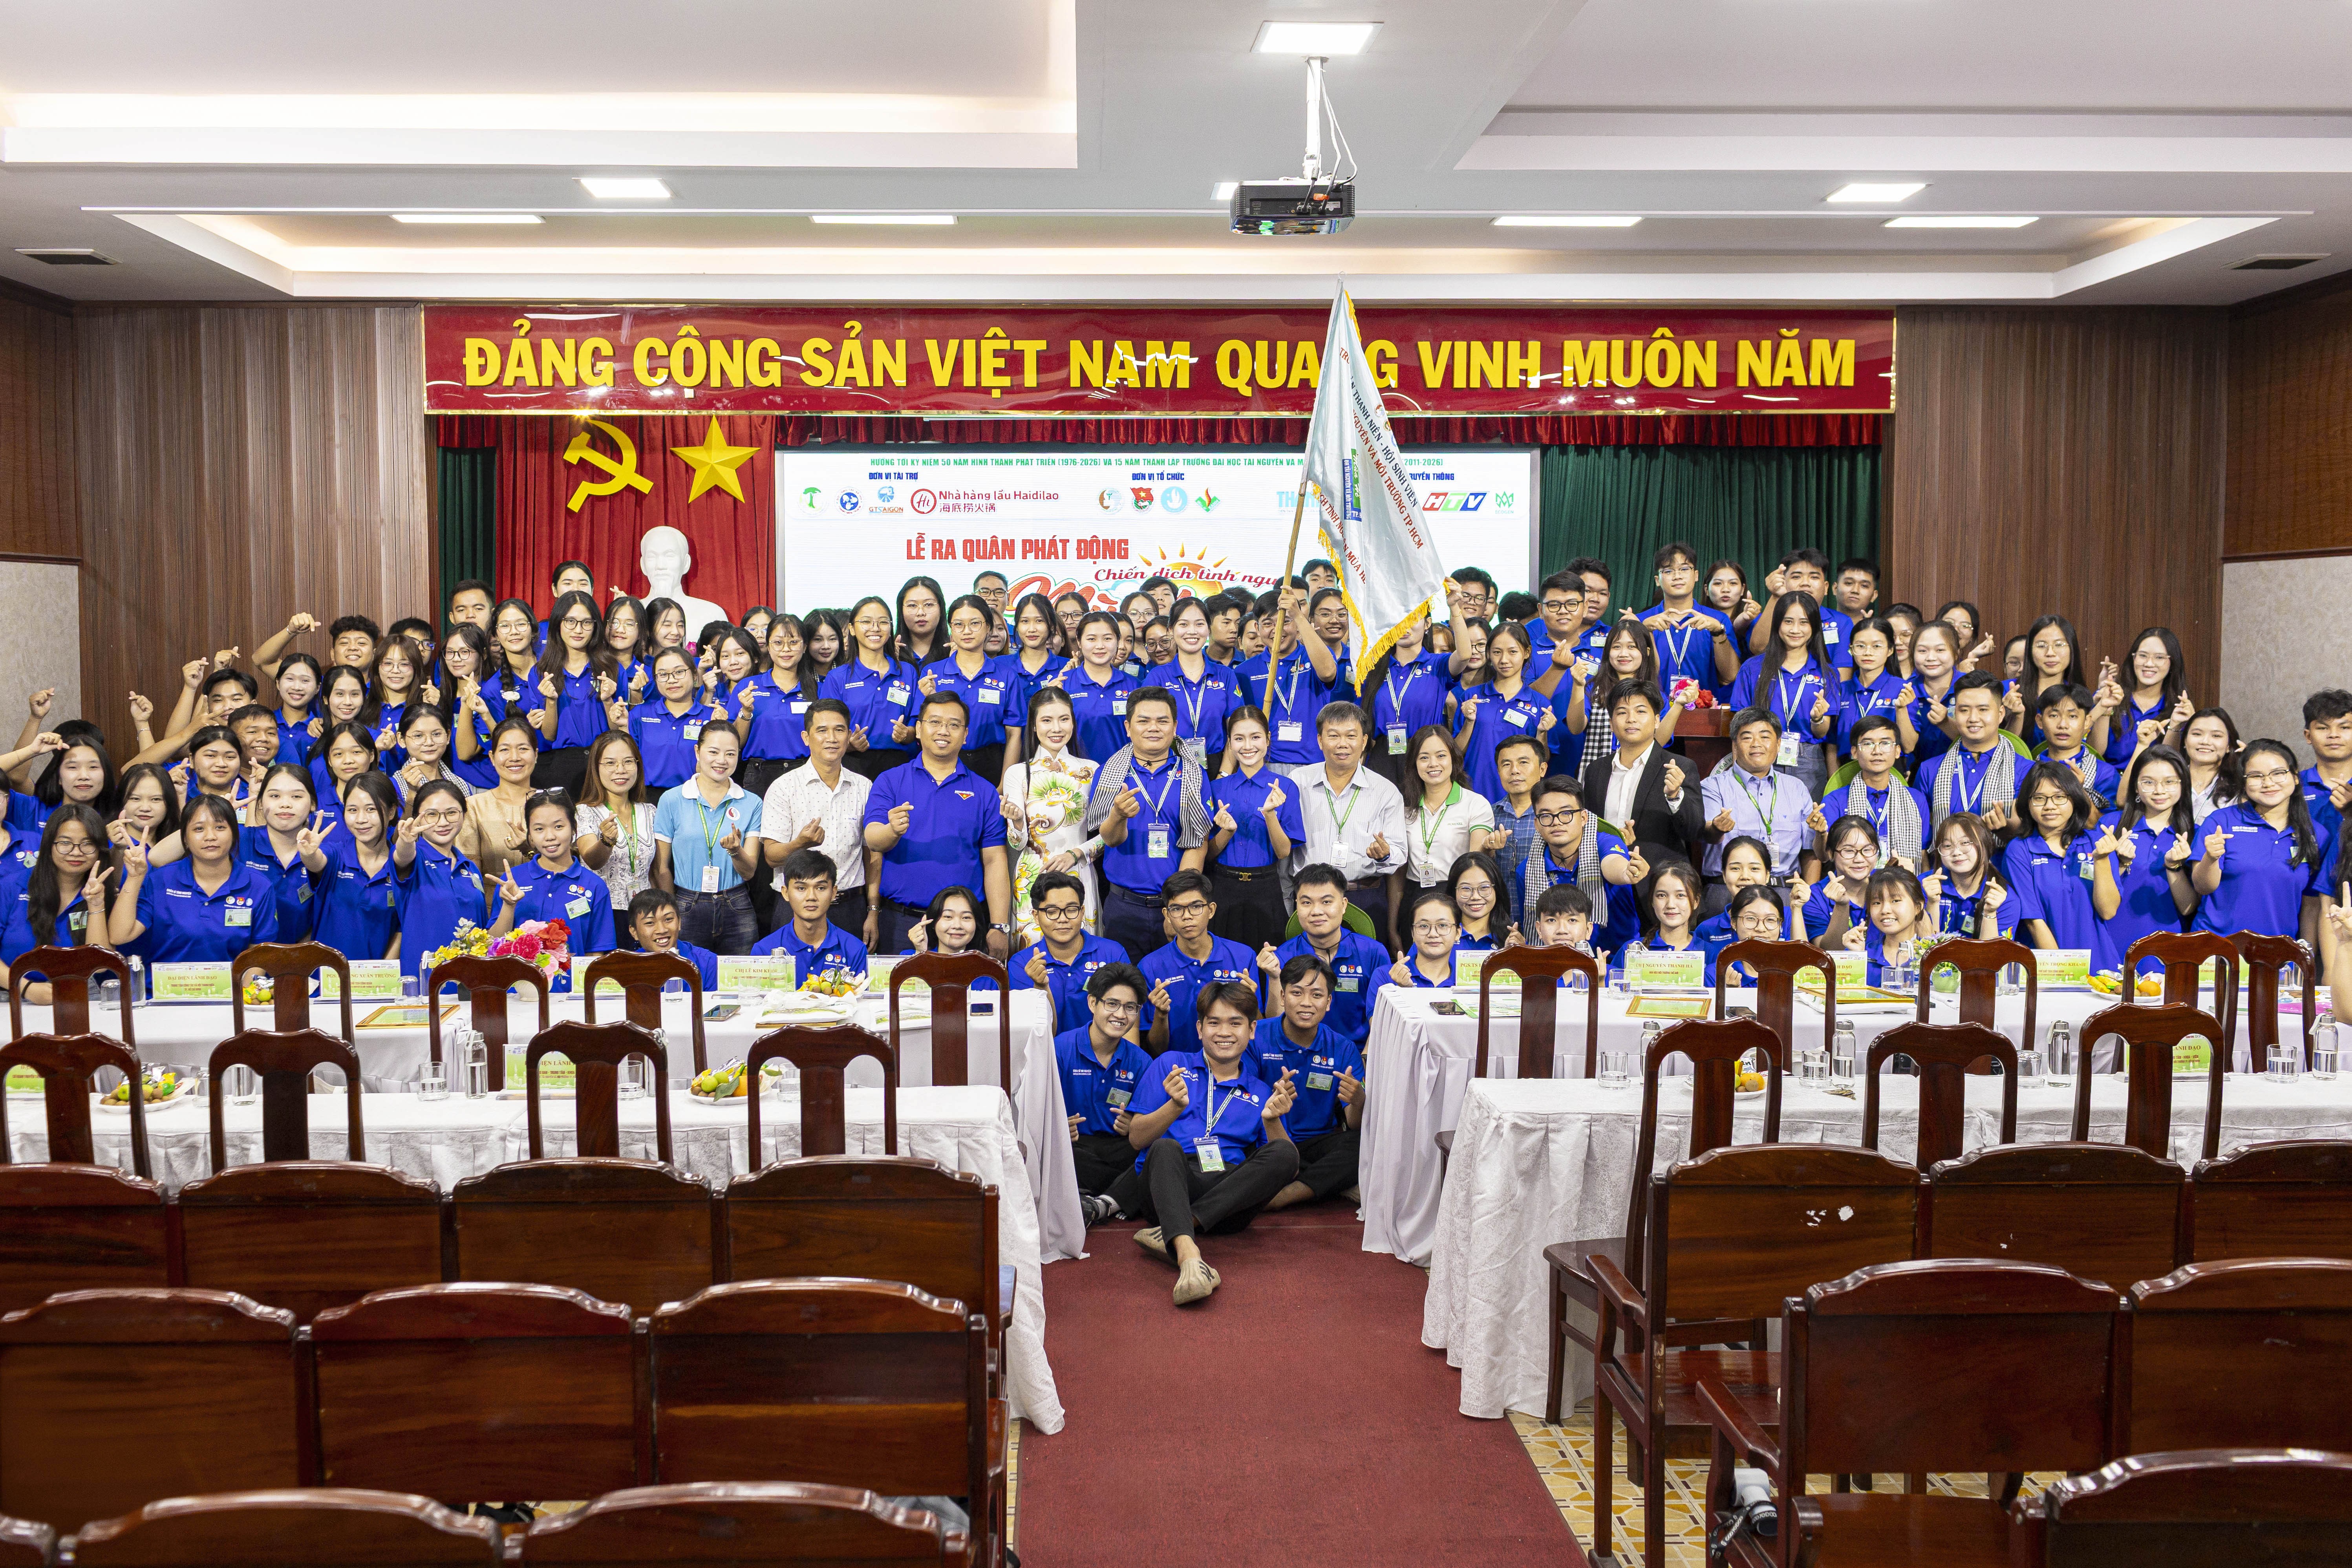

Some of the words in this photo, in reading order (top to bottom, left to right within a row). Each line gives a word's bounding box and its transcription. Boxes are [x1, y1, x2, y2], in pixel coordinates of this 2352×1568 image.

[463, 319, 613, 387] ĐẢNG
[634, 326, 781, 397] CỘNG
[800, 321, 906, 387] SẢN
[928, 327, 1046, 398] VIỆT
[1070, 340, 1190, 388] NAM
[1216, 340, 1398, 397] QUAG
[1417, 341, 1540, 388] VINH
[1563, 328, 1717, 388] MUÔN
[1737, 329, 1855, 387] NĂM
[1353, 390, 1370, 421] THANH
[1367, 419, 1383, 442] NIÊN
[1382, 445, 1395, 464] HỘI
[1392, 463, 1407, 486] SINH
[1405, 483, 1418, 508] VIÊN
[941, 457, 951, 466] 50
[1115, 457, 1122, 466] 15
[869, 472, 883, 480] ĐƠN
[894, 472, 903, 480] TÀI
[1132, 472, 1146, 481] ĐƠN
[1368, 444, 1377, 459] VÀ
[1374, 459, 1387, 478] MÔI
[1384, 476, 1406, 514] TRƯỜNG
[1432, 472, 1454, 480] THÔNG
[939, 490, 960, 500] Nhà
[964, 490, 990, 501] hàng
[994, 489, 1011, 500] lẩu
[1014, 490, 1059, 500] Haidilao
[1423, 493, 1487, 510] HTV
[940, 503, 996, 513] 海底捞火锅
[1325, 503, 1339, 523] TÌNH
[1346, 551, 1361, 572] MÙA
[907, 533, 925, 560] LỄ
[932, 539, 957, 560] RA
[963, 535, 1015, 562] QUÂN
[1022, 535, 1070, 560] PHÁT
[1076, 535, 1128, 564] ĐỘNG
[1095, 566, 1147, 581] Chiến
[1198, 569, 1237, 581] tình
